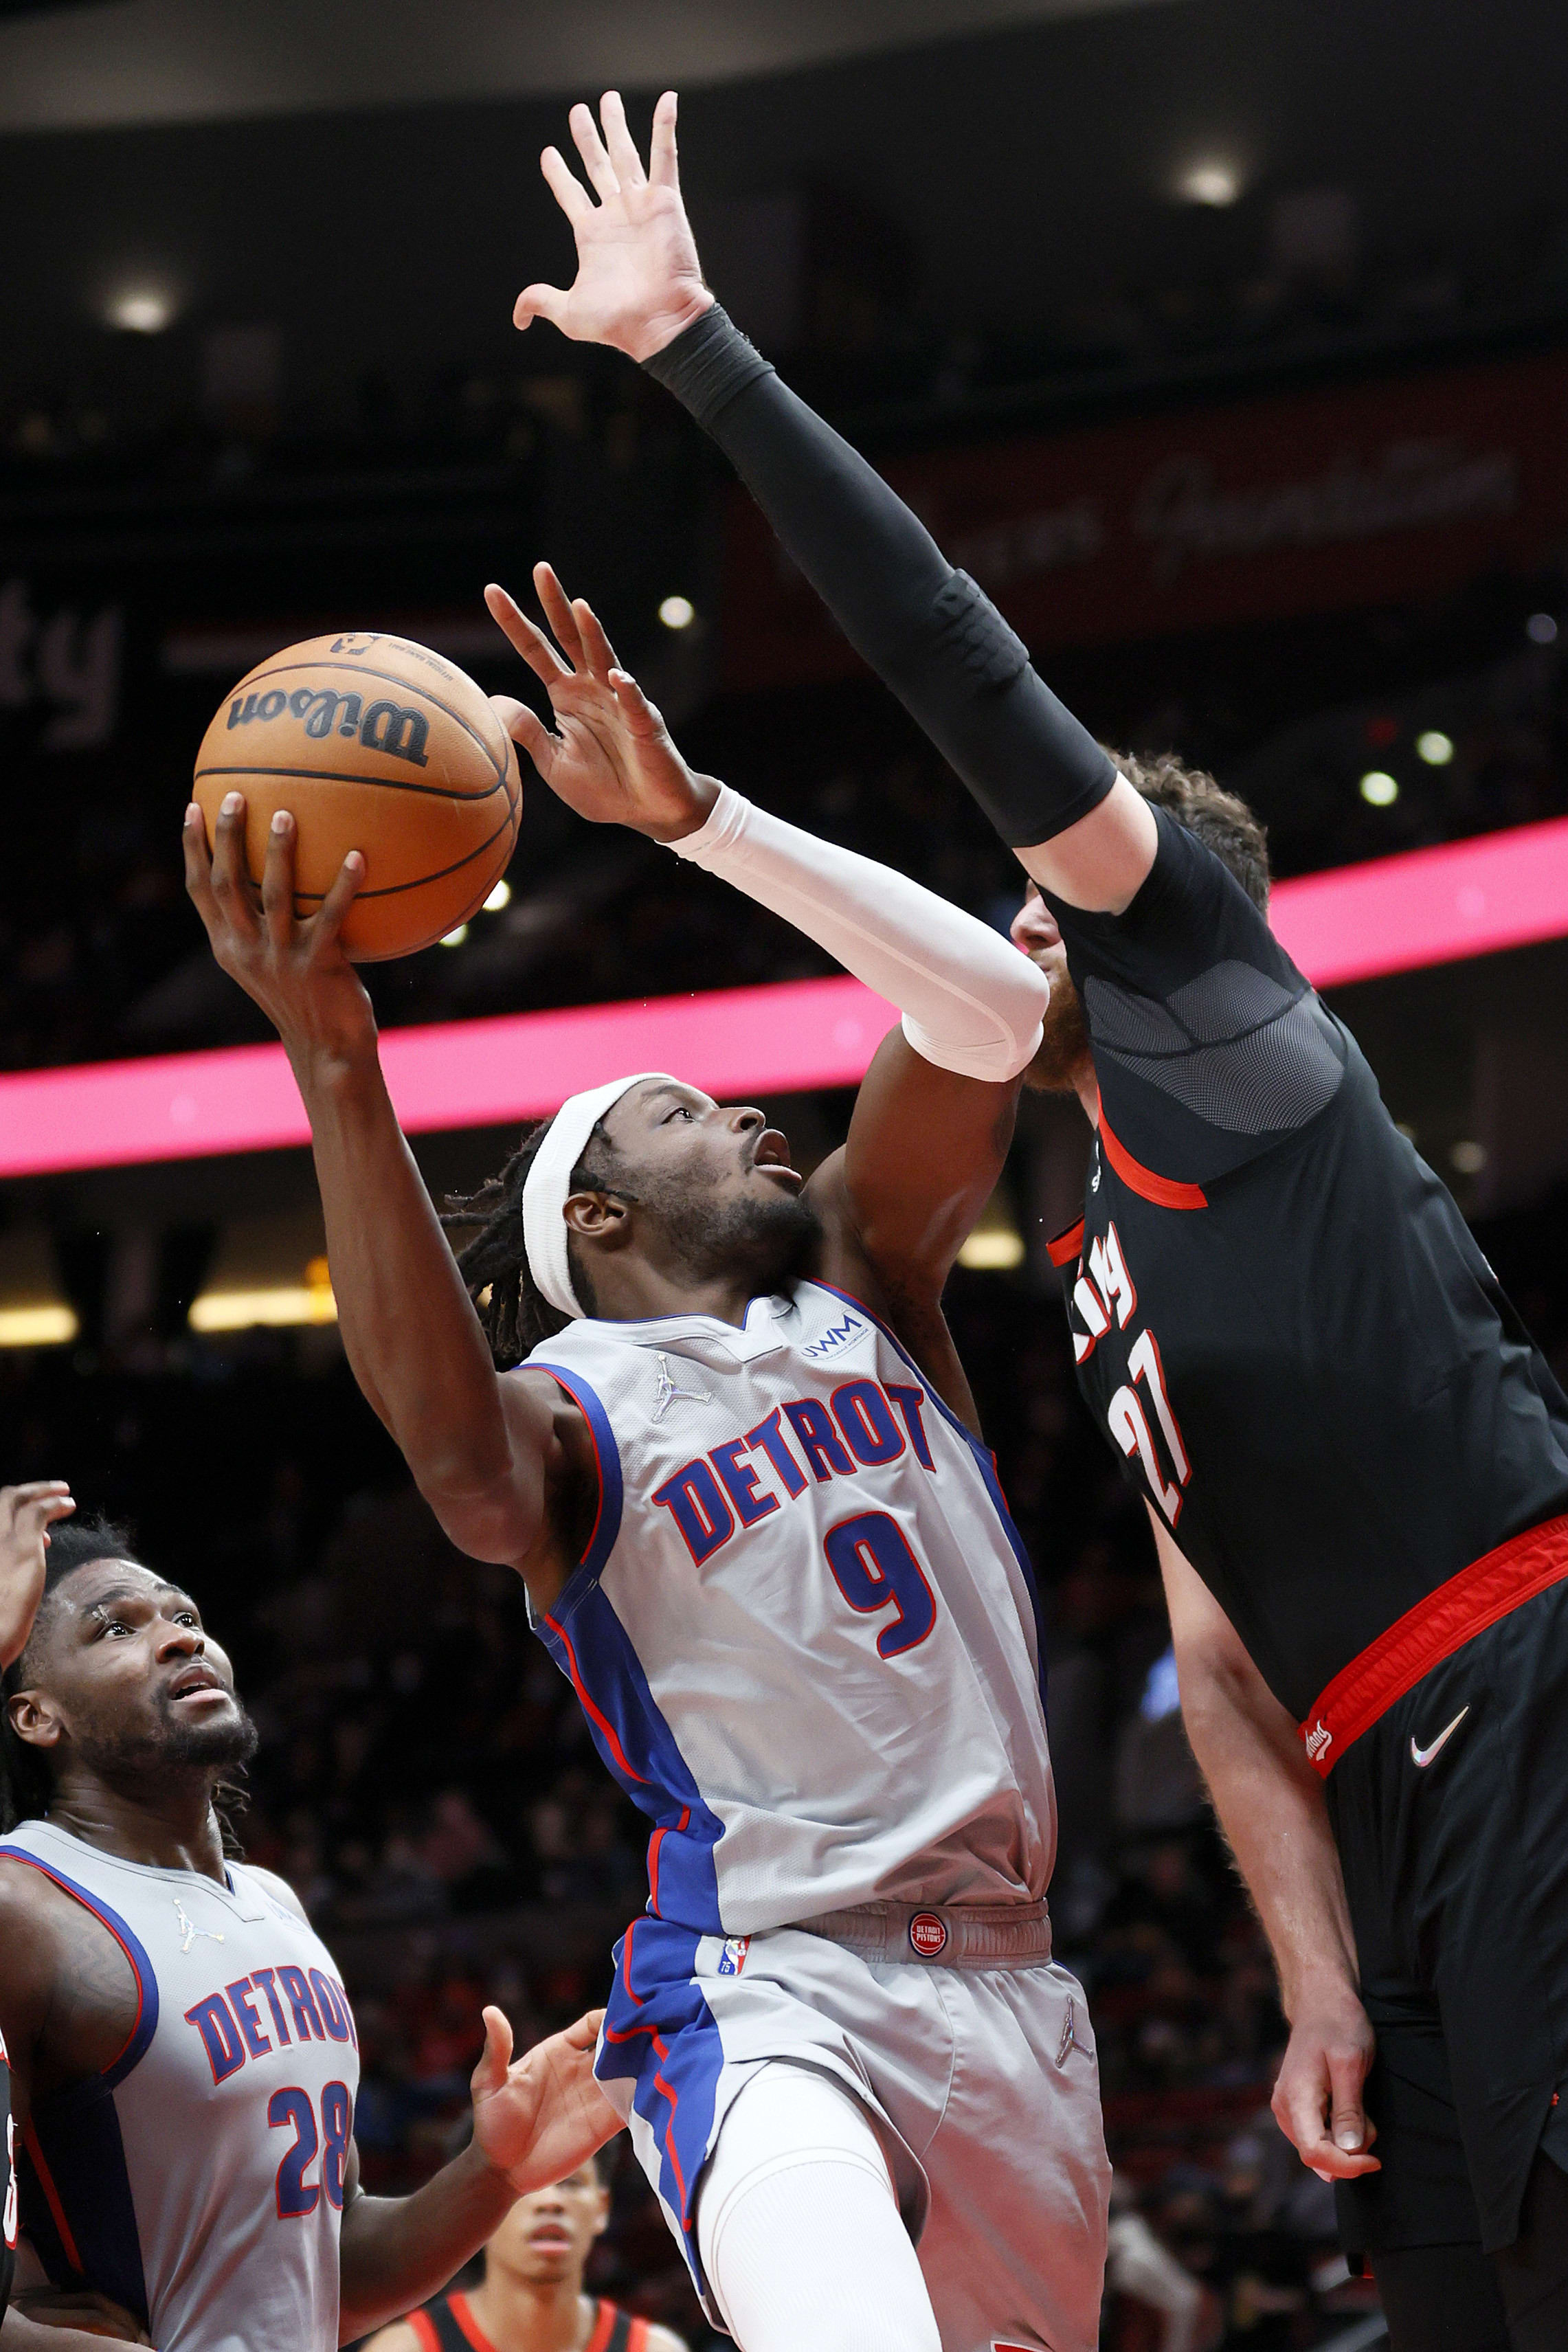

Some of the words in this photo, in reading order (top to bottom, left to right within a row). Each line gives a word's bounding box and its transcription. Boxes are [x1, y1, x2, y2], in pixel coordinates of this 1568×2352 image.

[227, 688, 429, 768] Wilson
[800, 1314, 862, 1357] UWM
[1108, 1328, 1193, 1530] 27
[651, 1378, 937, 1568] DETROT
[825, 1511, 937, 1659] 9
[721, 1960, 732, 1973] 75
[916, 1925, 941, 1934] DETROIT
[916, 1934, 941, 1943] PISTONS
[268, 2081, 349, 2219] 28
